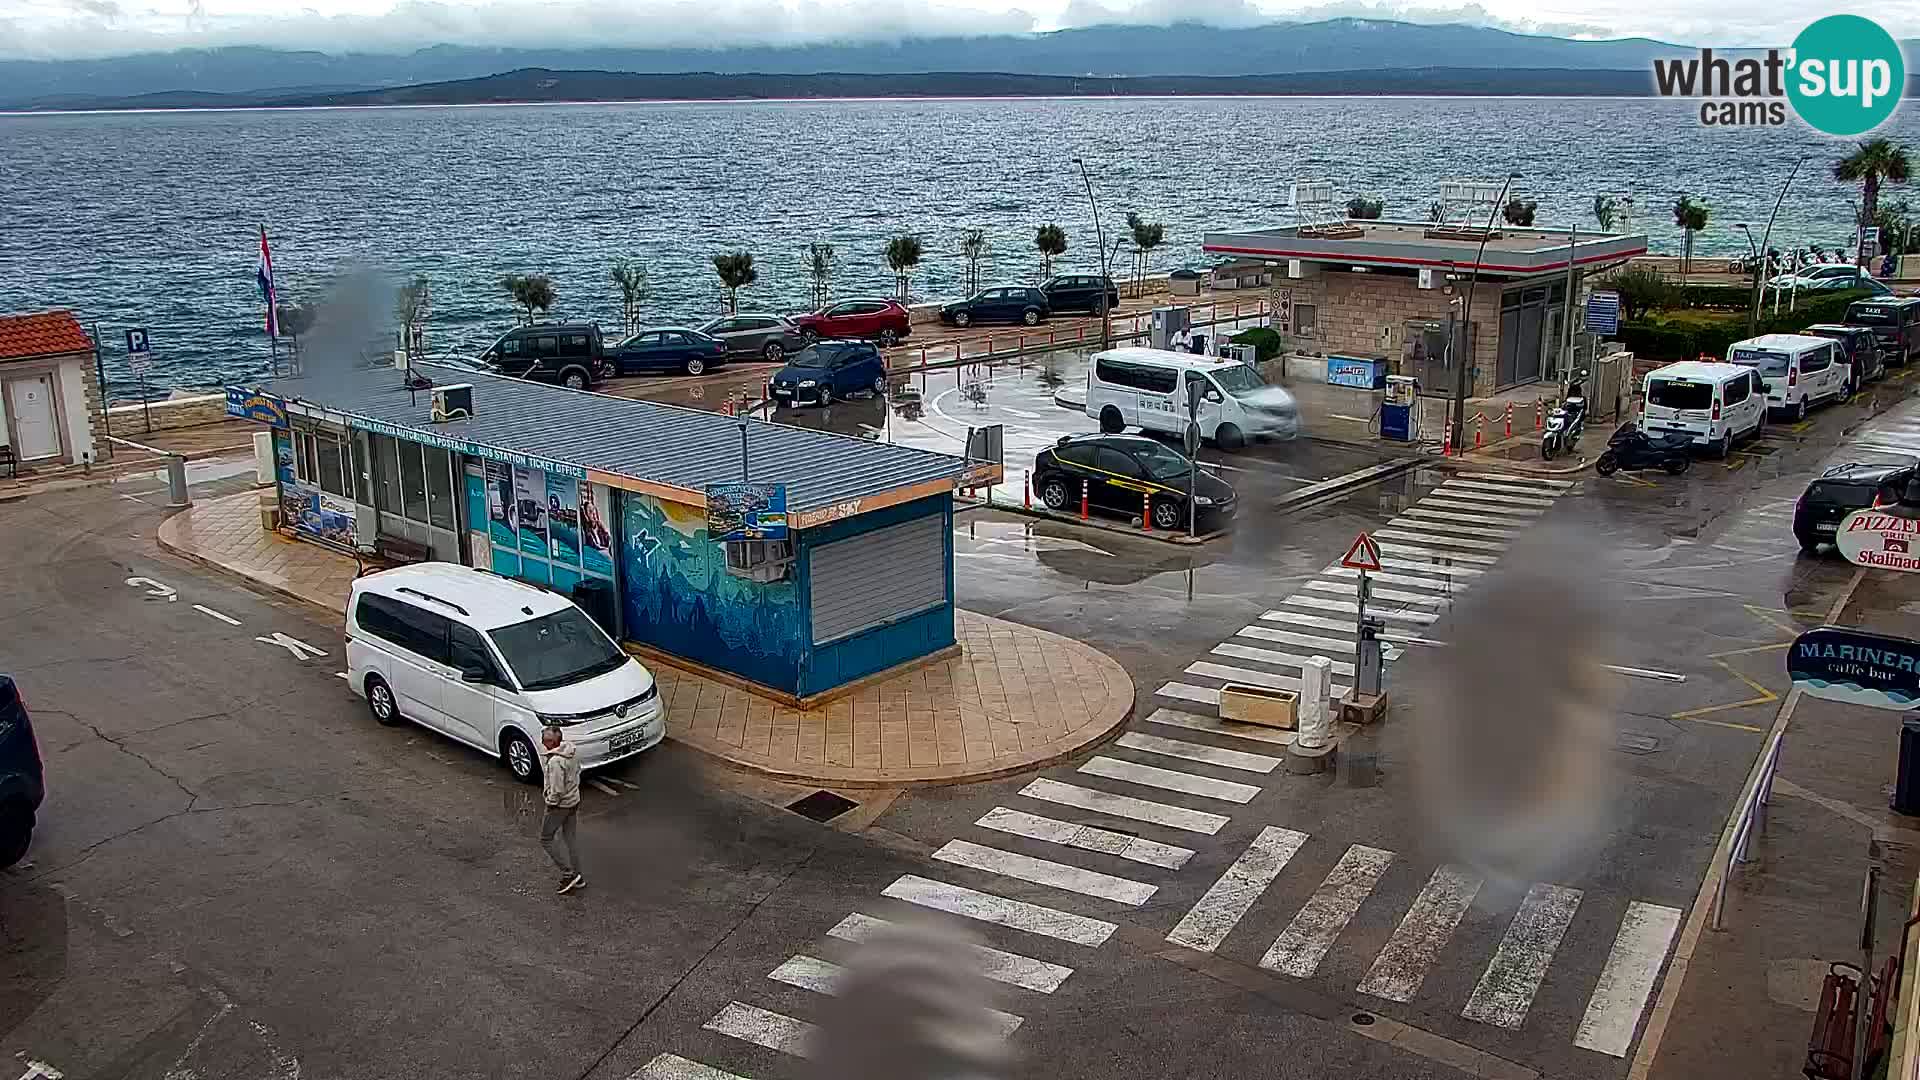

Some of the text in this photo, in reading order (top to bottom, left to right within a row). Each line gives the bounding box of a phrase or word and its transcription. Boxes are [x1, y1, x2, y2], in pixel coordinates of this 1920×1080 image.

[1736, 351, 1753, 360] TAXI
[396, 425, 437, 445] AUTOBUSNA
[437, 436, 469, 453] POSTAJA
[478, 446, 493, 458] BUS
[494, 449, 526, 465] STATION
[527, 457, 554, 473] TICKET
[556, 463, 583, 478] OFFICE
[1880, 531, 1913, 541] GRILL
[1828, 663, 1896, 681] caffe bar
